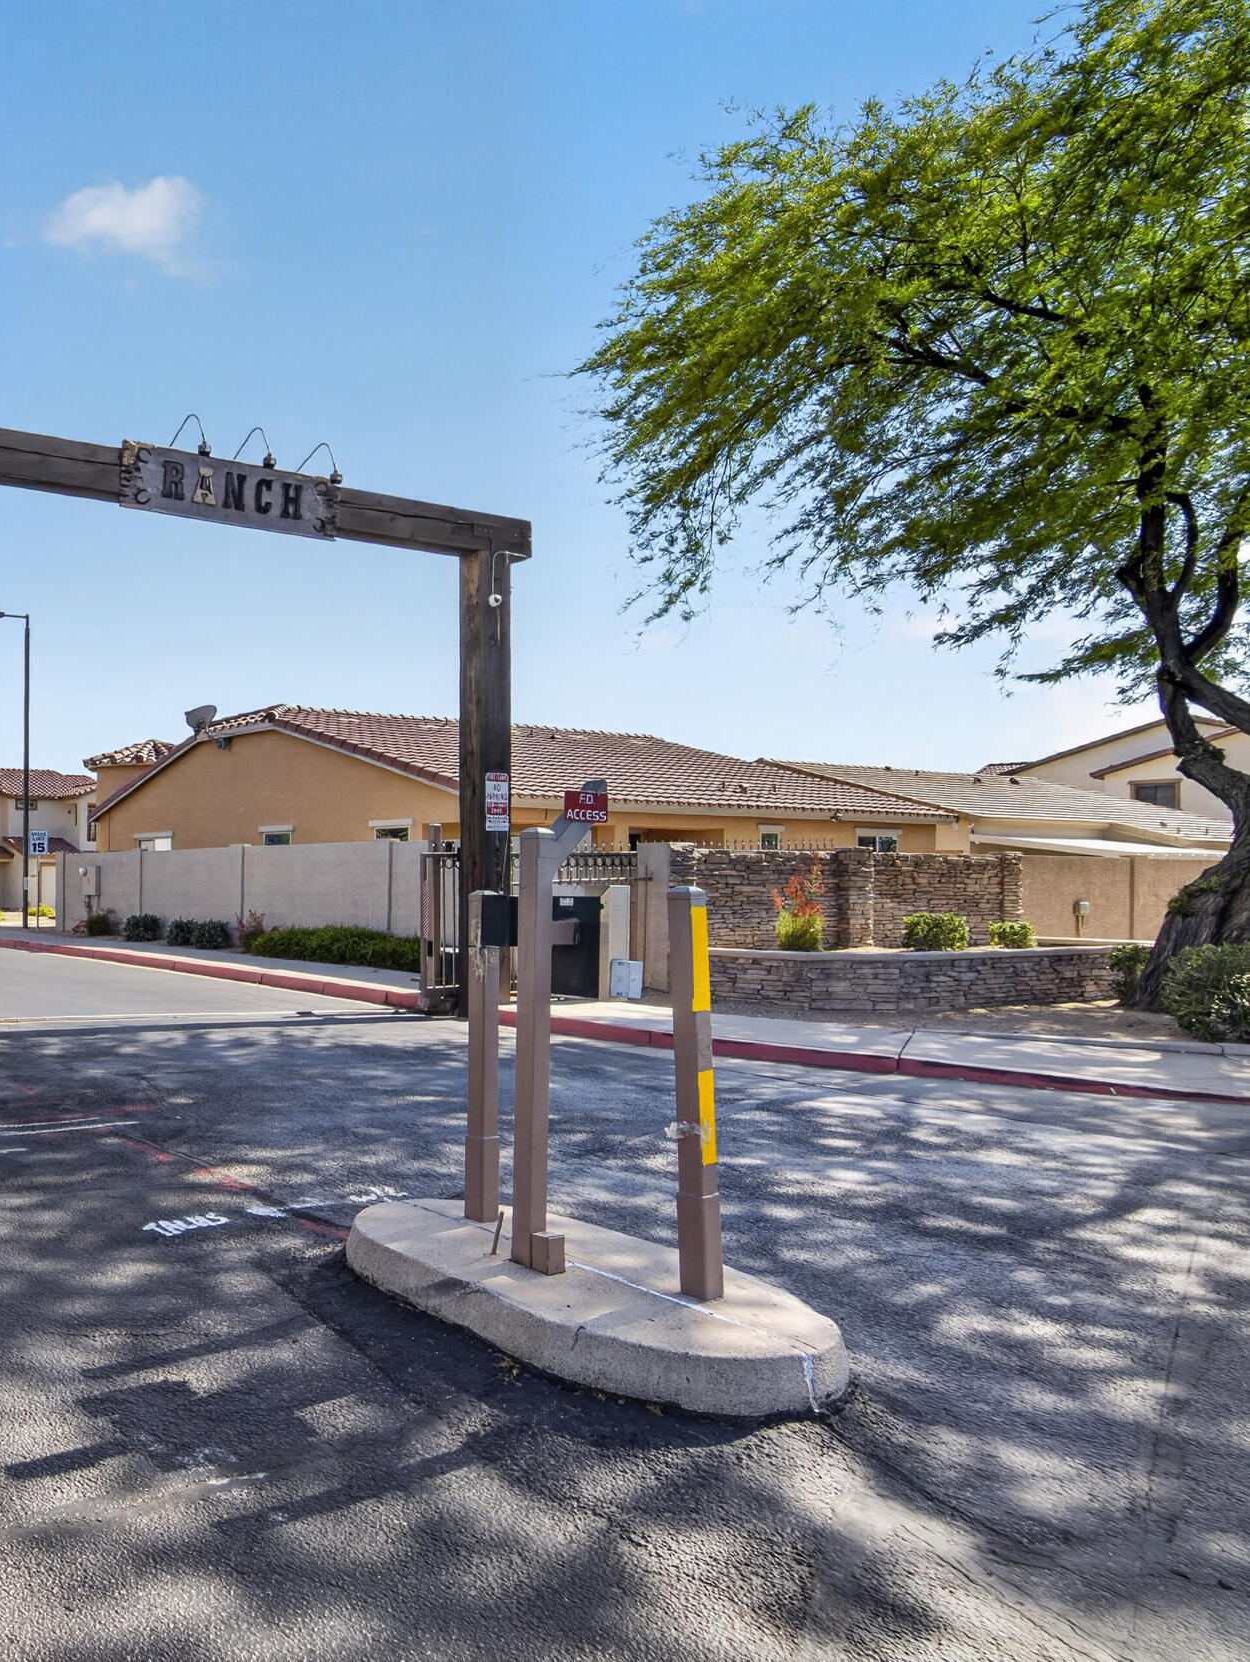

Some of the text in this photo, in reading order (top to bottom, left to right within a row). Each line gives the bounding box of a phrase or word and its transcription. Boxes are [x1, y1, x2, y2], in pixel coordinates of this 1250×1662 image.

[160, 459, 304, 520] RANCH
[566, 808, 607, 822] ACCESS
[31, 842, 46, 853] 15
